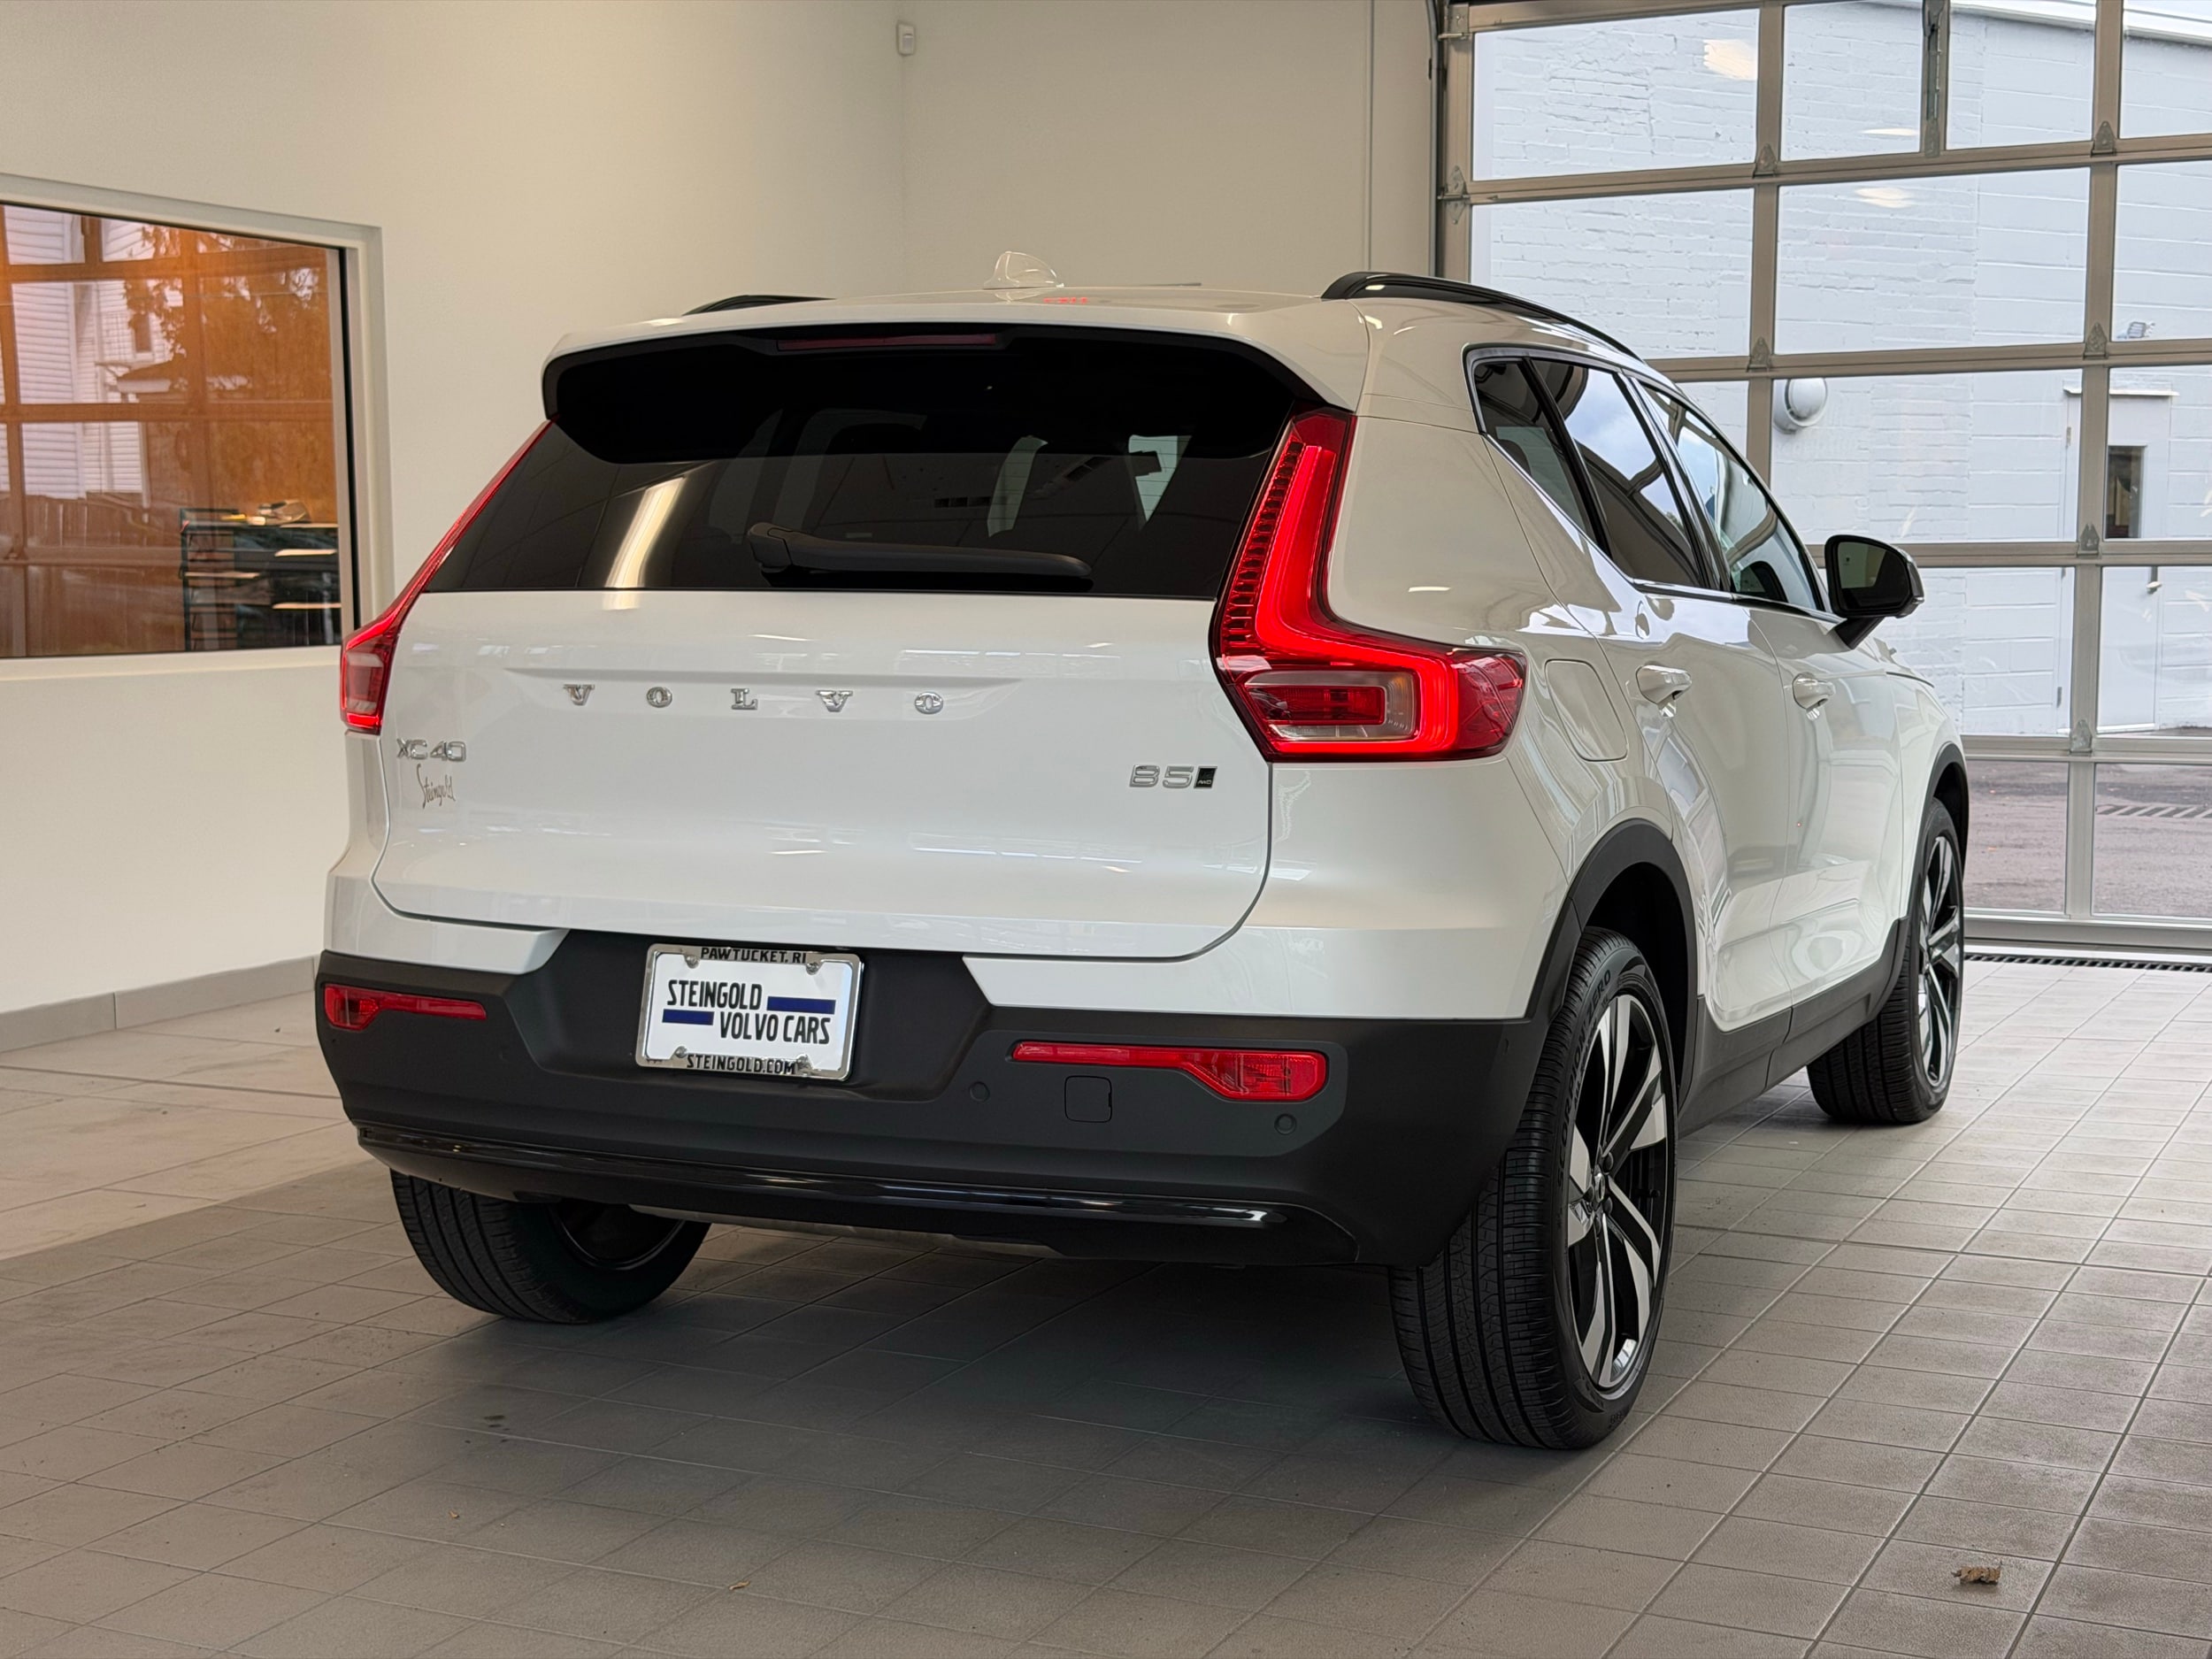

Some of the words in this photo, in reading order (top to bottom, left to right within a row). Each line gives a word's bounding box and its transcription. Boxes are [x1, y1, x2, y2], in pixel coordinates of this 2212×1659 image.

[563, 684, 944, 715] VOLVO
[397, 739, 466, 762] XC40
[1129, 764, 1194, 788] B5
[792, 952, 807, 964] RI
[667, 979, 763, 1010] STEINGOLD
[1586, 969, 1611, 1018] ZERO
[719, 1011, 779, 1041] VOLVO
[783, 1016, 831, 1044] CARS
[687, 1053, 796, 1075] STEINGOLD.COM
